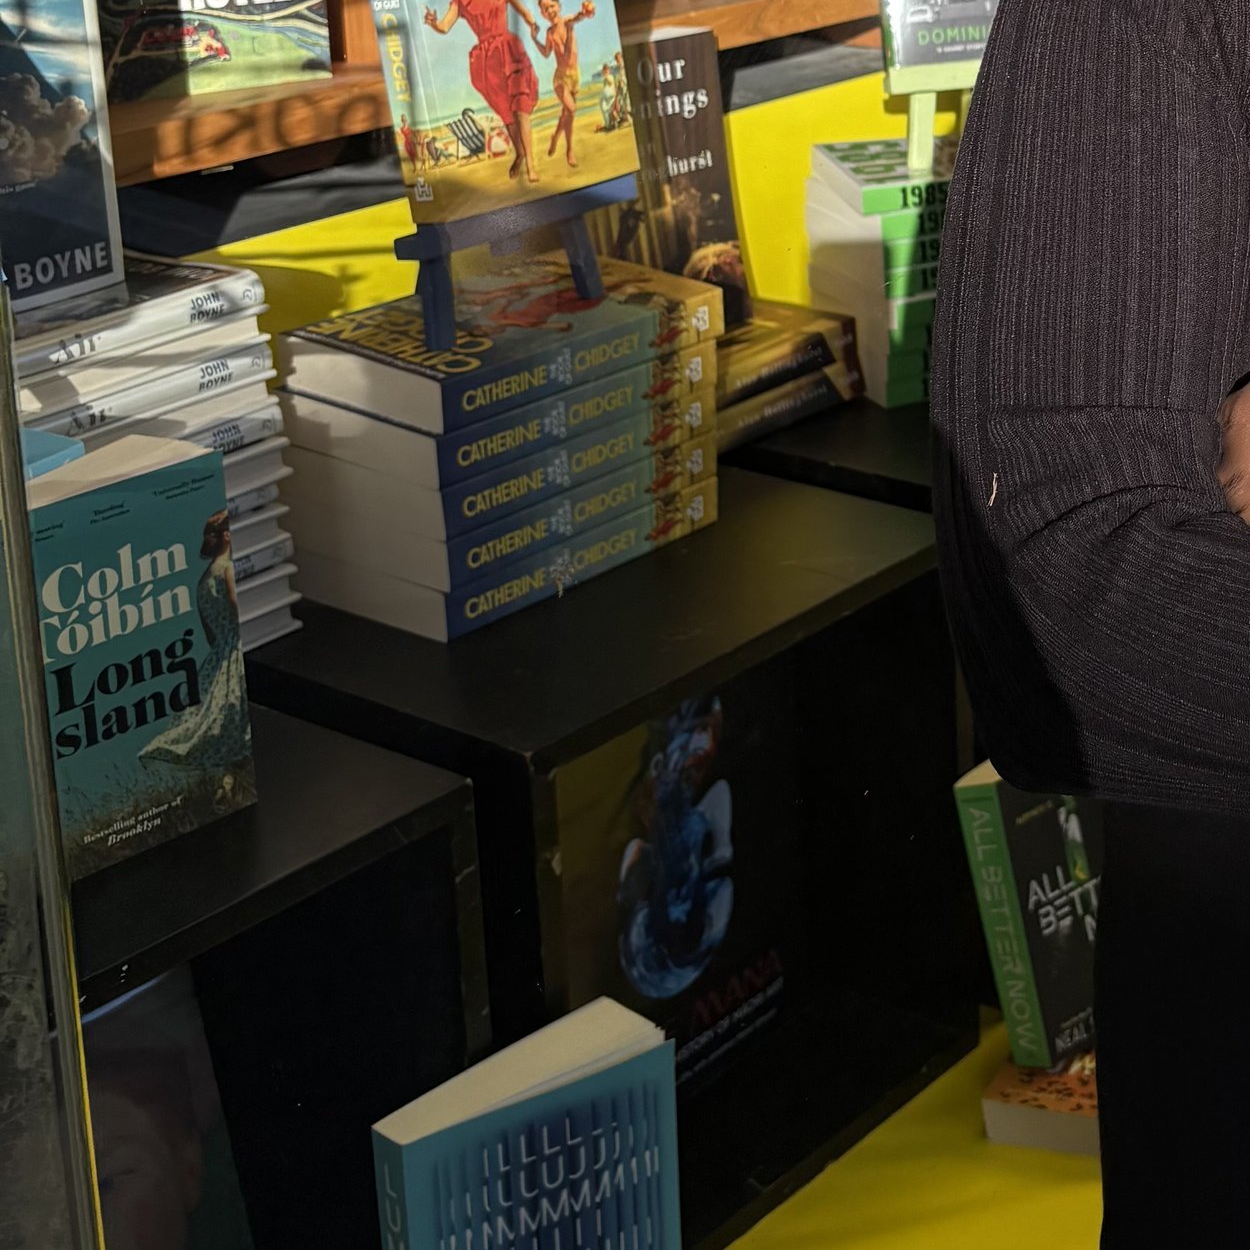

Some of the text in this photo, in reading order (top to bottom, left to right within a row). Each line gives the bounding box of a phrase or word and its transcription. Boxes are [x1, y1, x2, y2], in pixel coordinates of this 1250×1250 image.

[380, 13, 411, 103] CHIDGEY
[918, 25, 987, 47] DOMINI
[637, 56, 685, 86] Our
[14, 241, 109, 290] BOYNE
[190, 304, 226, 323] BOYNE
[191, 291, 221, 310] JOHN
[199, 372, 234, 391] BOYNE
[200, 358, 230, 379] JOHN
[462, 364, 547, 412] CATHERINE
[575, 332, 641, 373] CHIDGEY
[212, 423, 242, 442] JOHN
[457, 418, 542, 468] CATHERINE
[569, 384, 635, 427] CHIDGEY
[462, 469, 545, 519] CATHERINE
[572, 432, 636, 474] CHIDGEY
[466, 518, 549, 570] CATHERINE
[575, 479, 638, 522] CHIDGEY
[42, 543, 189, 614] Colm
[464, 572, 547, 620] CATHERINE
[575, 527, 638, 571] CHIDGEY
[49, 629, 195, 716] Long
[56, 658, 200, 760] sland
[107, 817, 161, 846] Brooklyn
[138, 803, 169, 821] author
[171, 795, 185, 806] of
[1028, 864, 1076, 910] ALL
[1038, 875, 1099, 936] BETT
[968, 806, 1041, 1051] ALL BETTER NOW
